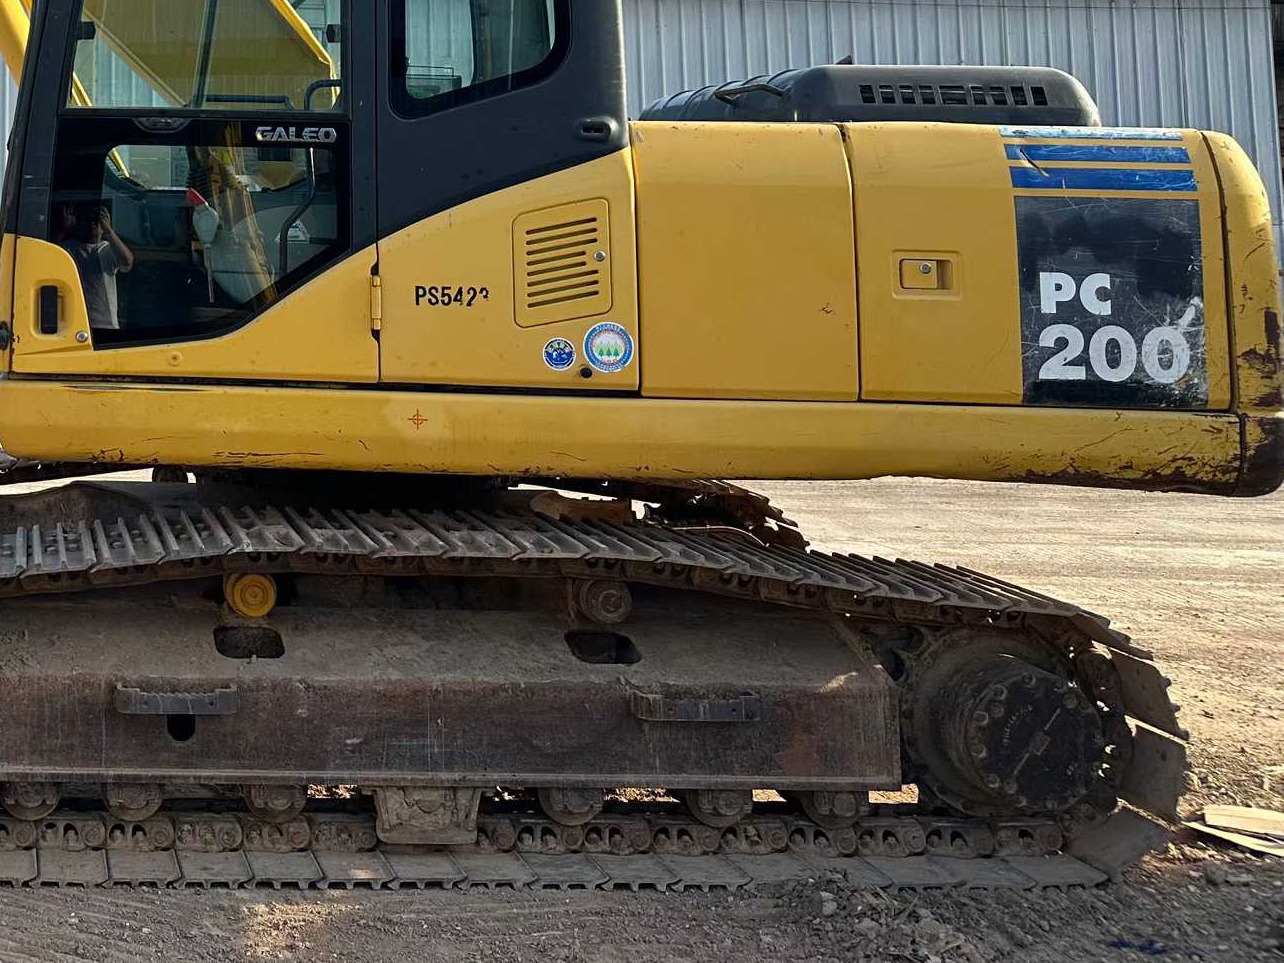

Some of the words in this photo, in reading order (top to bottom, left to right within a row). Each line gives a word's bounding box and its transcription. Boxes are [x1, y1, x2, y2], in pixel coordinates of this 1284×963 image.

[255, 126, 337, 143] GALEO
[1038, 272, 1112, 316] PC
[1038, 323, 1190, 384] 200
